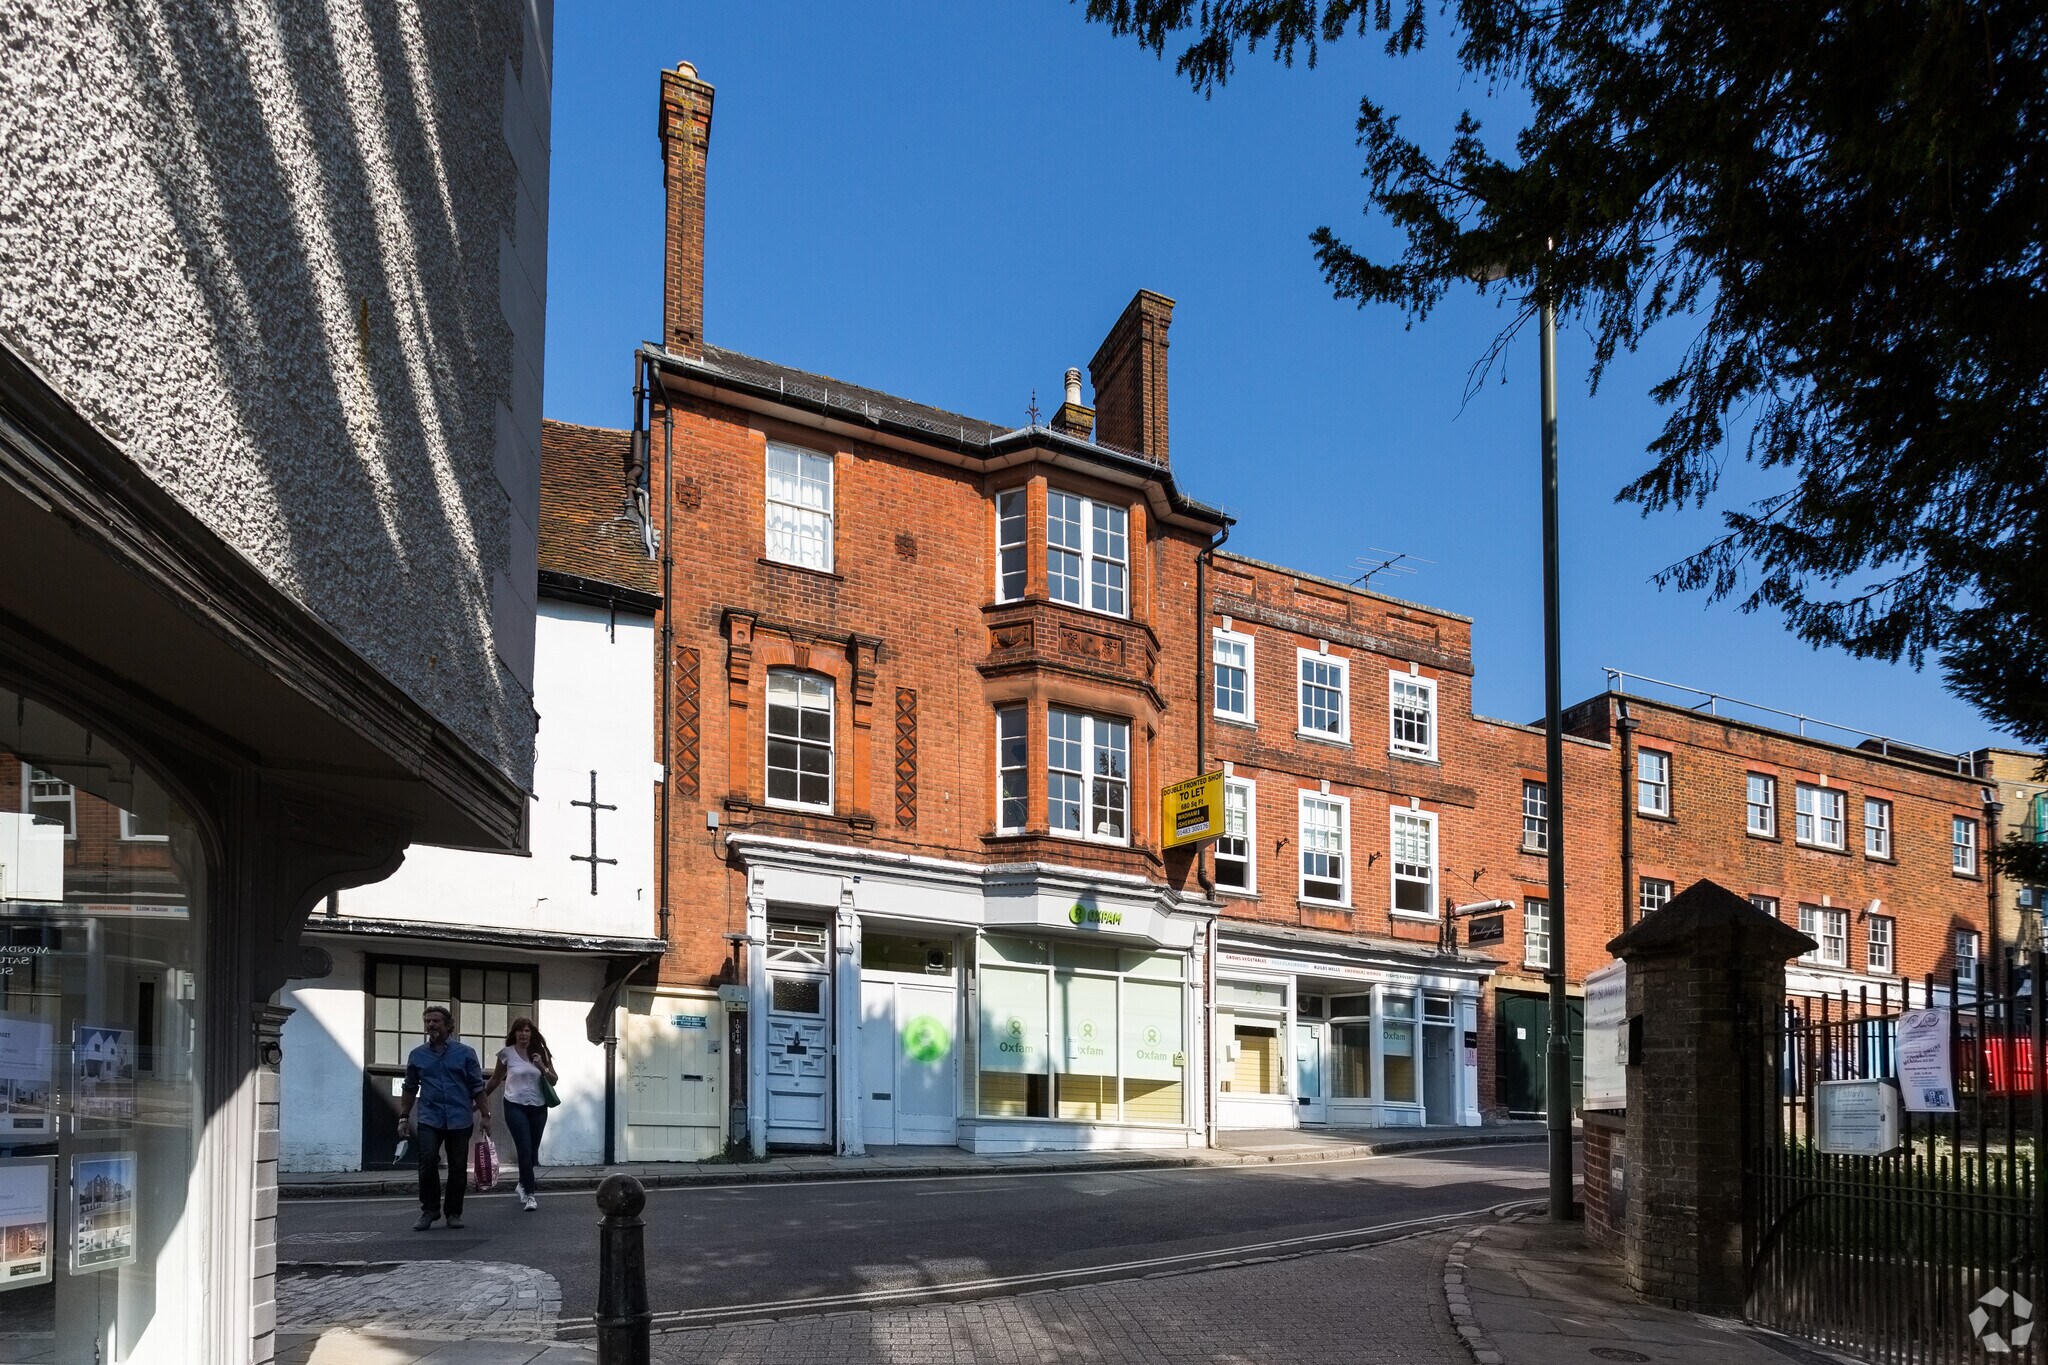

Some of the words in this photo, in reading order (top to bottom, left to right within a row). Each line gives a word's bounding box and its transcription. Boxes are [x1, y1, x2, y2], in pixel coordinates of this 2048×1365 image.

[1163, 785, 1182, 796] DOUBLE
[1184, 778, 1206, 788] FRONTED
[1208, 773, 1222, 782] SHOP
[1180, 791, 1190, 801] TO
[1191, 786, 1204, 798] LET
[1178, 816, 1204, 828] ISHERWOOD
[1088, 909, 1122, 925] OXFAM
[1383, 1031, 1406, 1041] Oxfam
[1000, 1041, 1033, 1053] Oxfam
[1078, 1045, 1104, 1056] xfam
[1136, 1049, 1168, 1061] Oxfam
